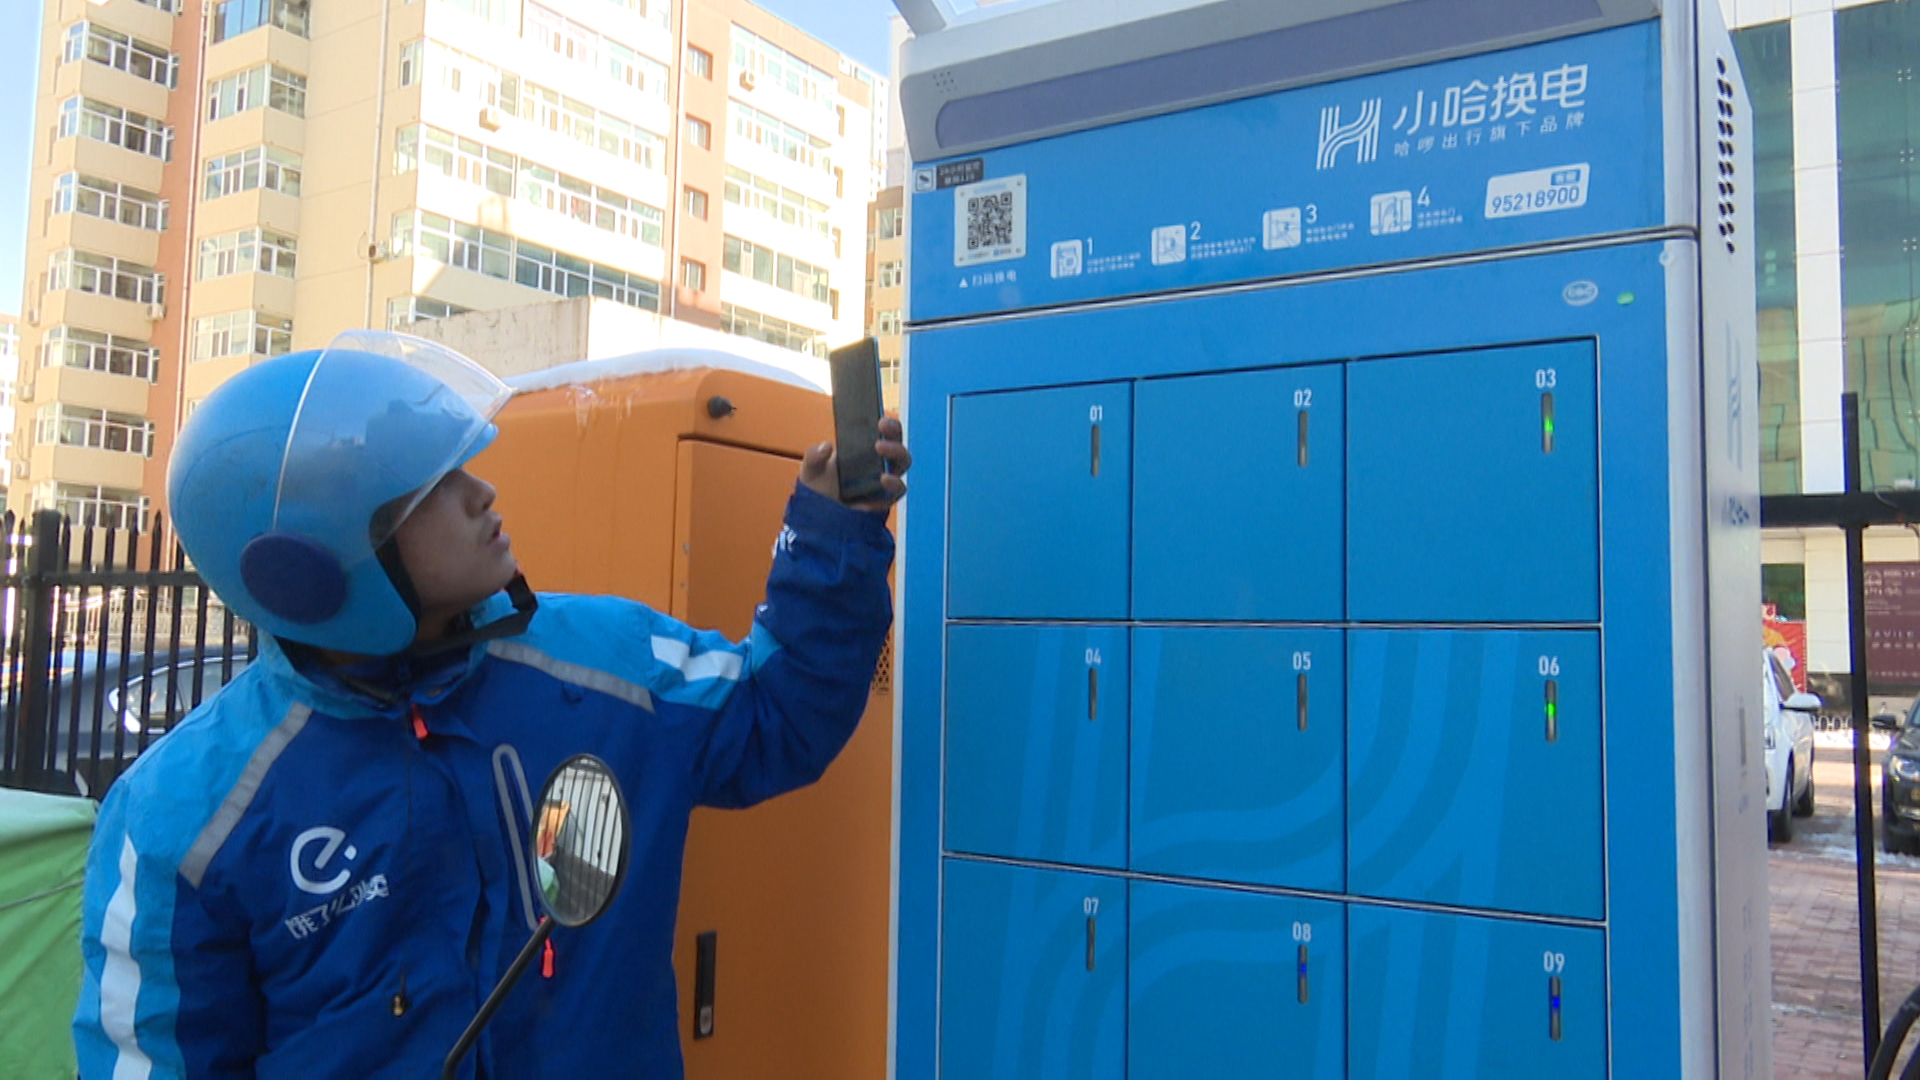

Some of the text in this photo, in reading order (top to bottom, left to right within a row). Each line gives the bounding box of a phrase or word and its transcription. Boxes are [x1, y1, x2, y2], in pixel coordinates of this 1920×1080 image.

[1392, 63, 1588, 135] 小哈换电
[1417, 185, 1430, 207] 4
[1492, 185, 1580, 214] 95218900
[1305, 203, 1317, 224] 3
[1190, 221, 1201, 240] 2
[1087, 237, 1093, 255] 1
[1535, 368, 1556, 389] 03
[1293, 388, 1312, 408] 02
[1090, 405, 1103, 422] 01
[1085, 647, 1102, 665] 04
[1292, 651, 1312, 670] 05
[1538, 654, 1560, 676] 06
[1083, 897, 1099, 915] 07
[1292, 920, 1312, 942] 08
[1543, 950, 1565, 973] 09
